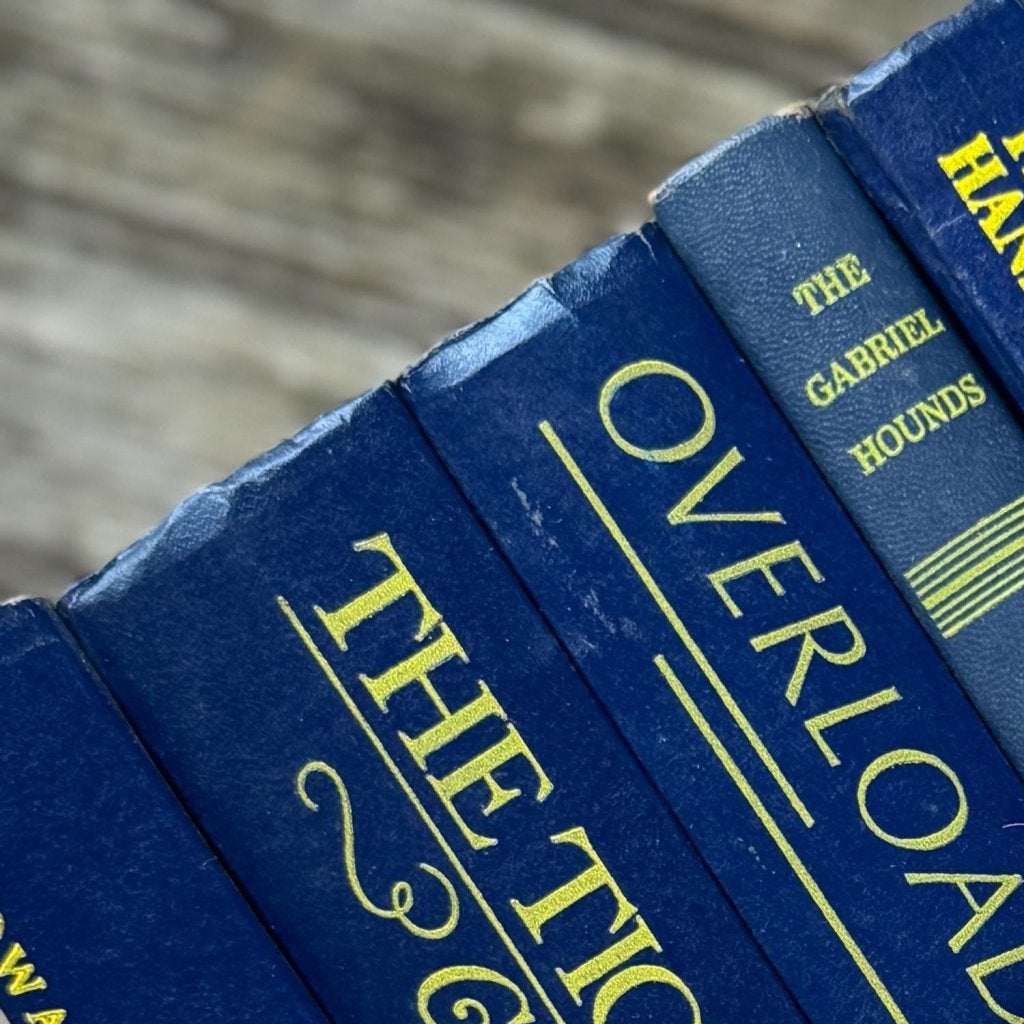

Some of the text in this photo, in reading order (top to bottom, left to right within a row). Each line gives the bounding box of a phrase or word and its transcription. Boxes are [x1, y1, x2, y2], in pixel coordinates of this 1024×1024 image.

[793, 252, 871, 317] THE
[804, 307, 946, 408] GABRIEL
[848, 373, 987, 476] HOUNDS
[312, 532, 555, 852] THE
